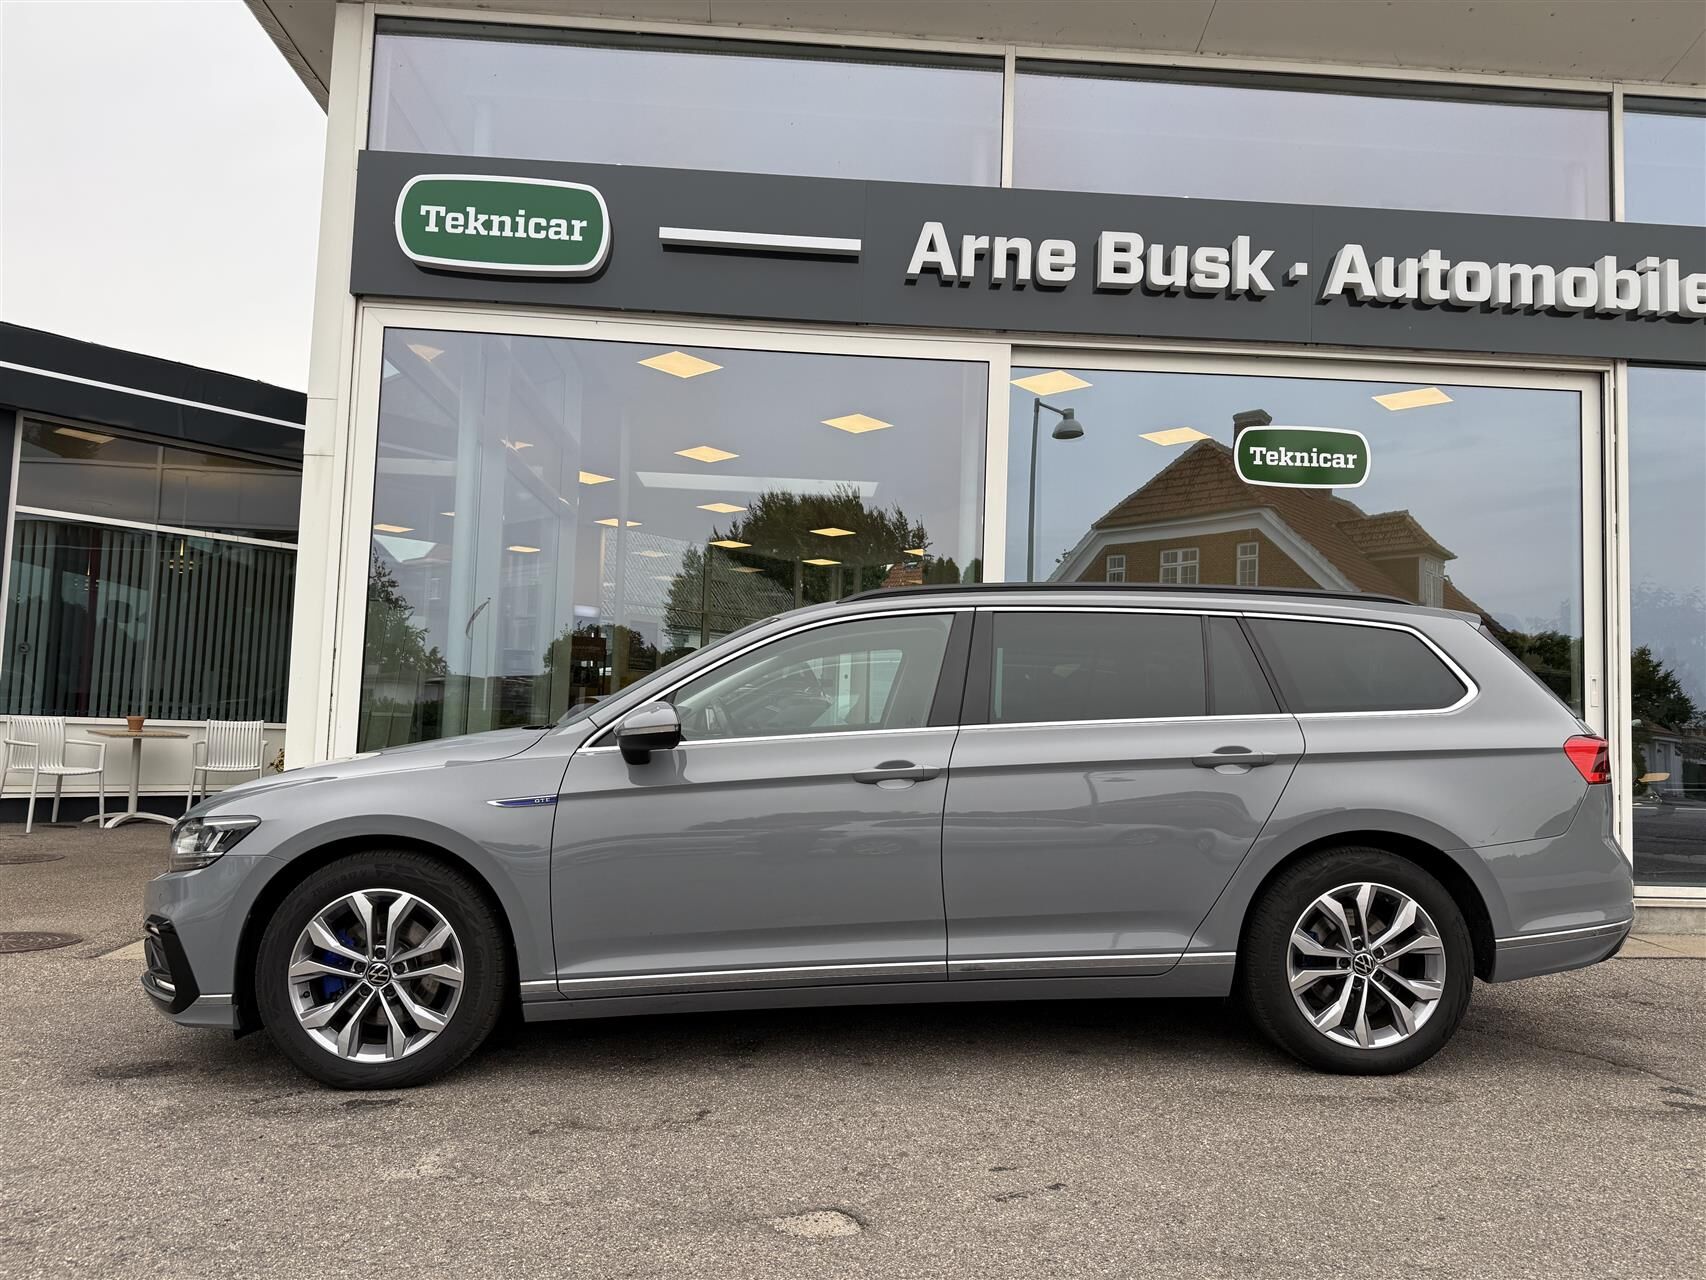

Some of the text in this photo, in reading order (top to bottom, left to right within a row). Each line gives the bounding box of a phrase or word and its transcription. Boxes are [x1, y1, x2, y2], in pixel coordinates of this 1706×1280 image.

[420, 204, 588, 241] Teknicar
[906, 221, 1077, 283] Arne
[1100, 230, 1275, 292] Busk
[1249, 446, 1358, 470] Teknicar
